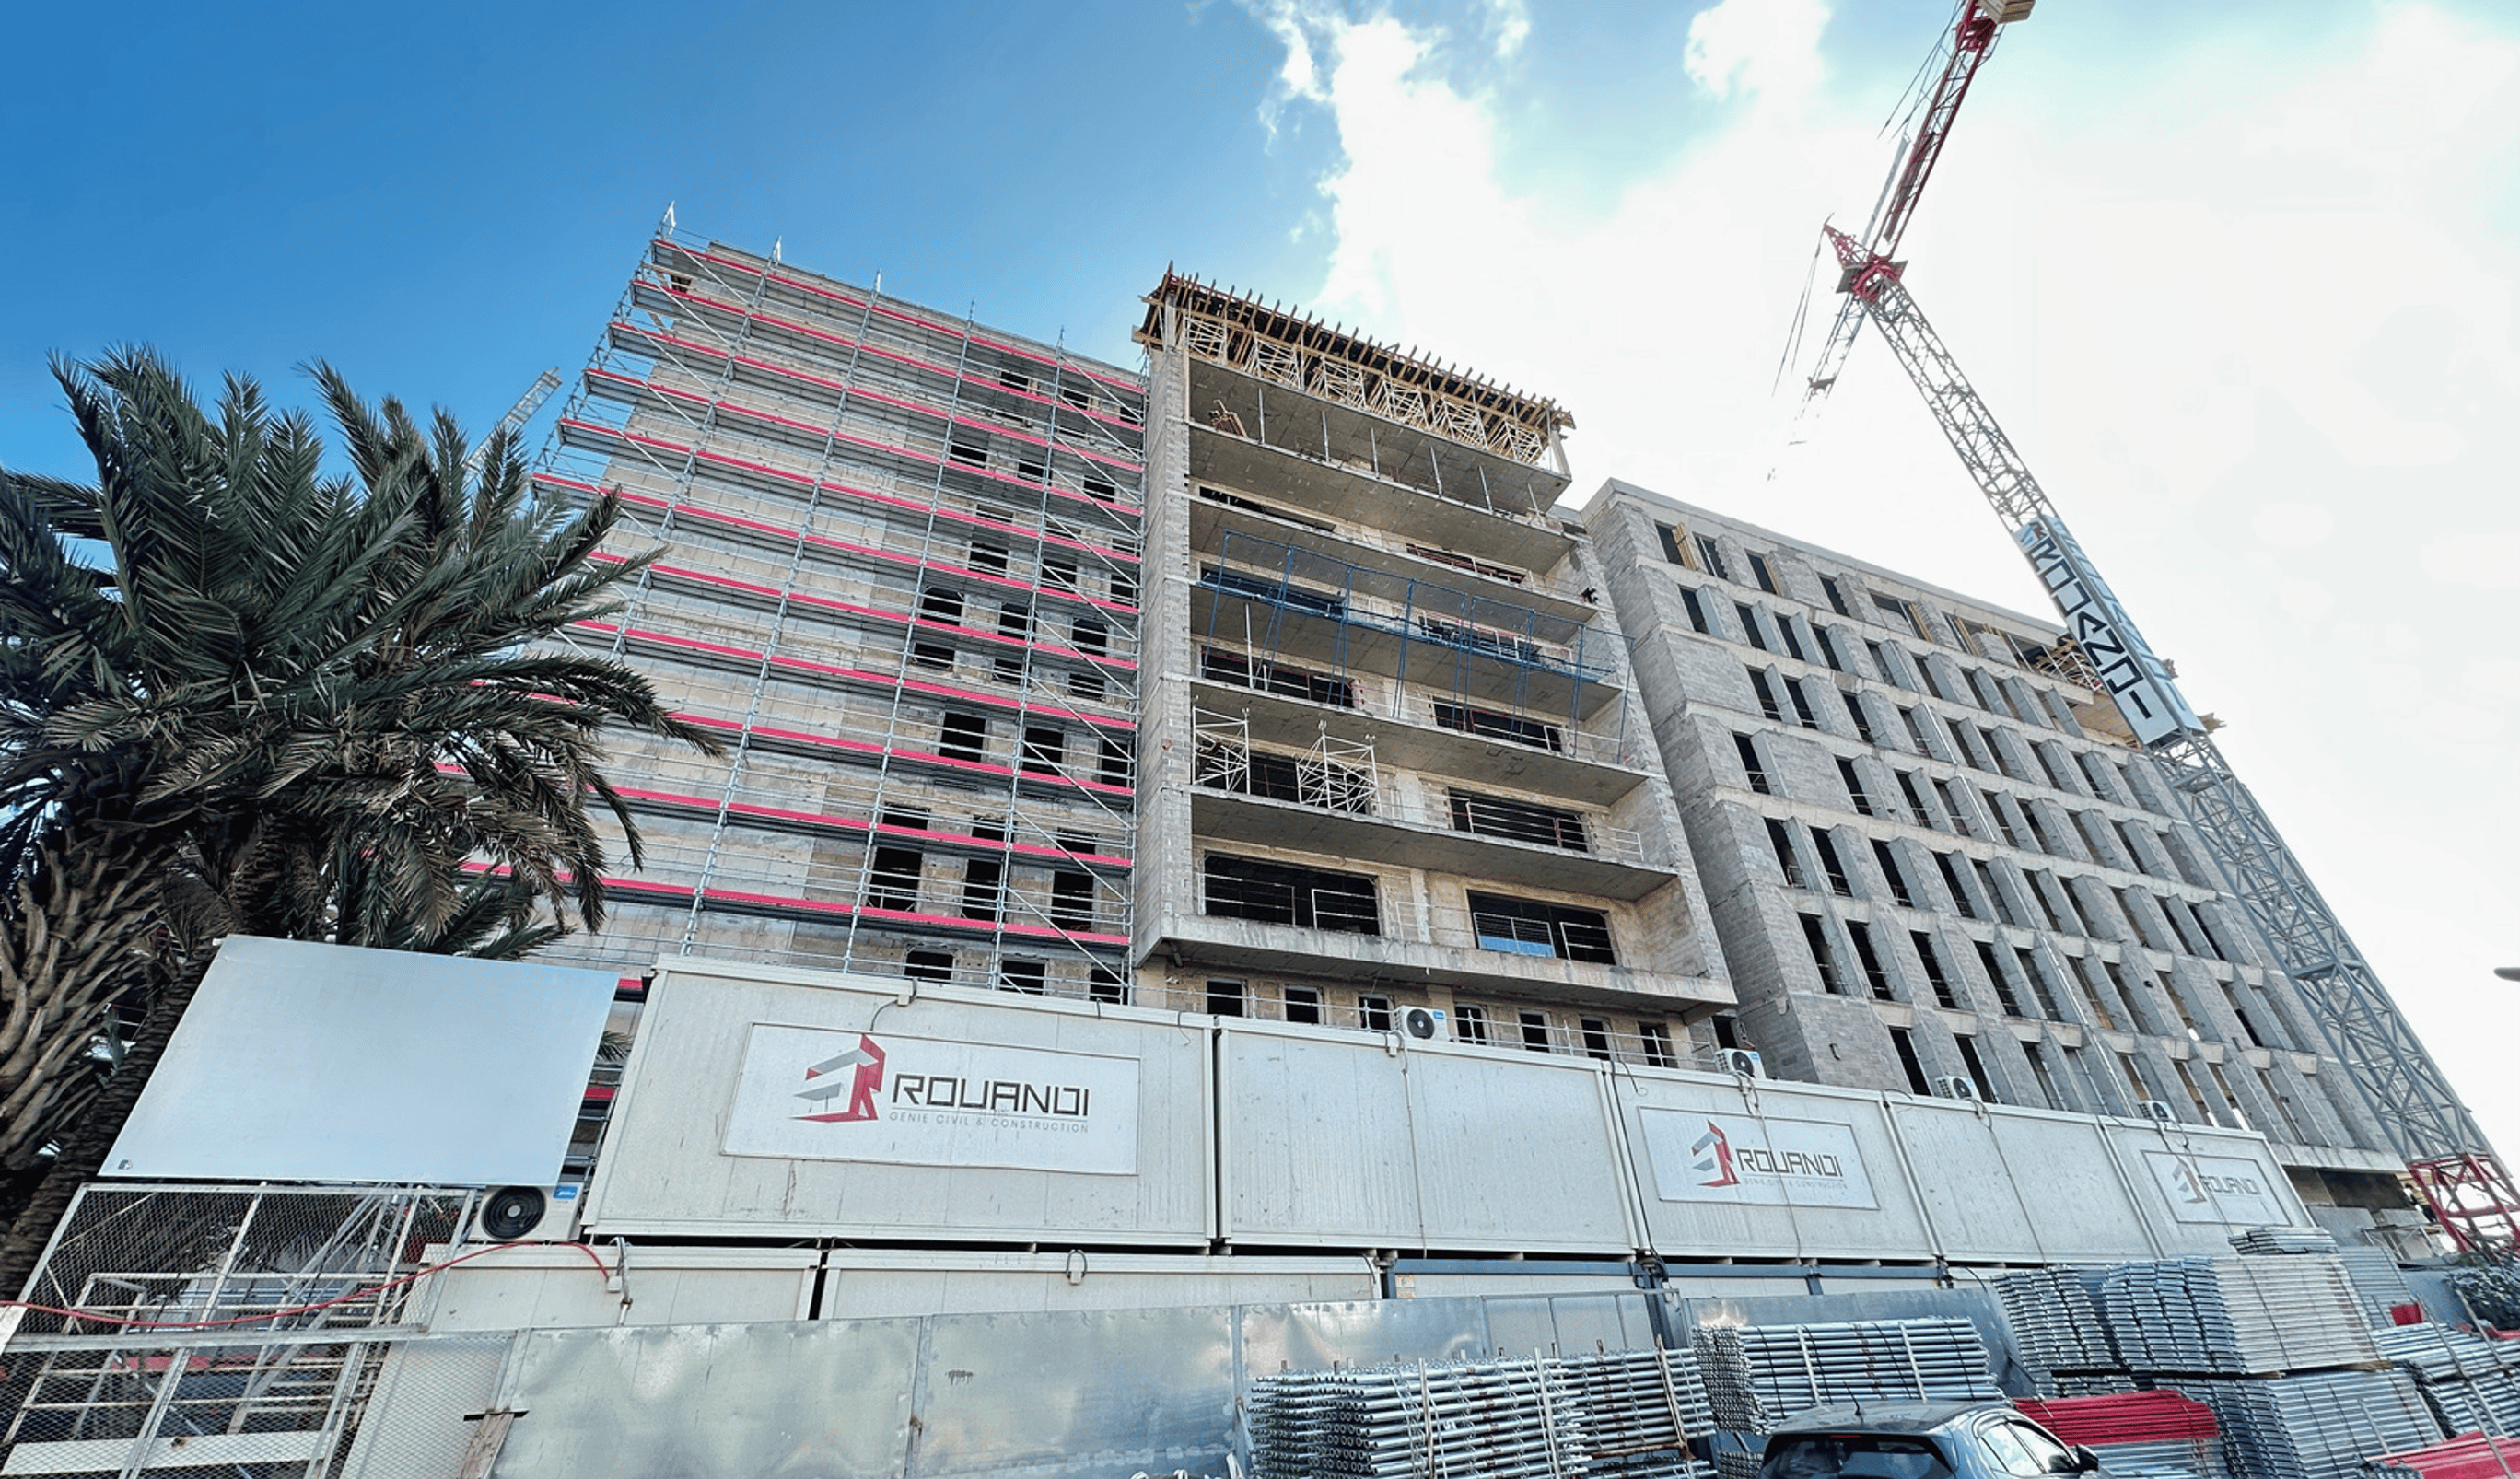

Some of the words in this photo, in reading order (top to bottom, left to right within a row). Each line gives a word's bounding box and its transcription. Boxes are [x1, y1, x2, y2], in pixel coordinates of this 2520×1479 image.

[2026, 536, 2152, 720] ROUANDI
[891, 1072, 1091, 1117] ROUANDI
[889, 1111, 928, 1124] GENIE
[935, 1113, 970, 1126] CIVIL
[990, 1117, 1089, 1134] CONSTRUCTION
[1735, 1148, 1844, 1178] ROUANDI
